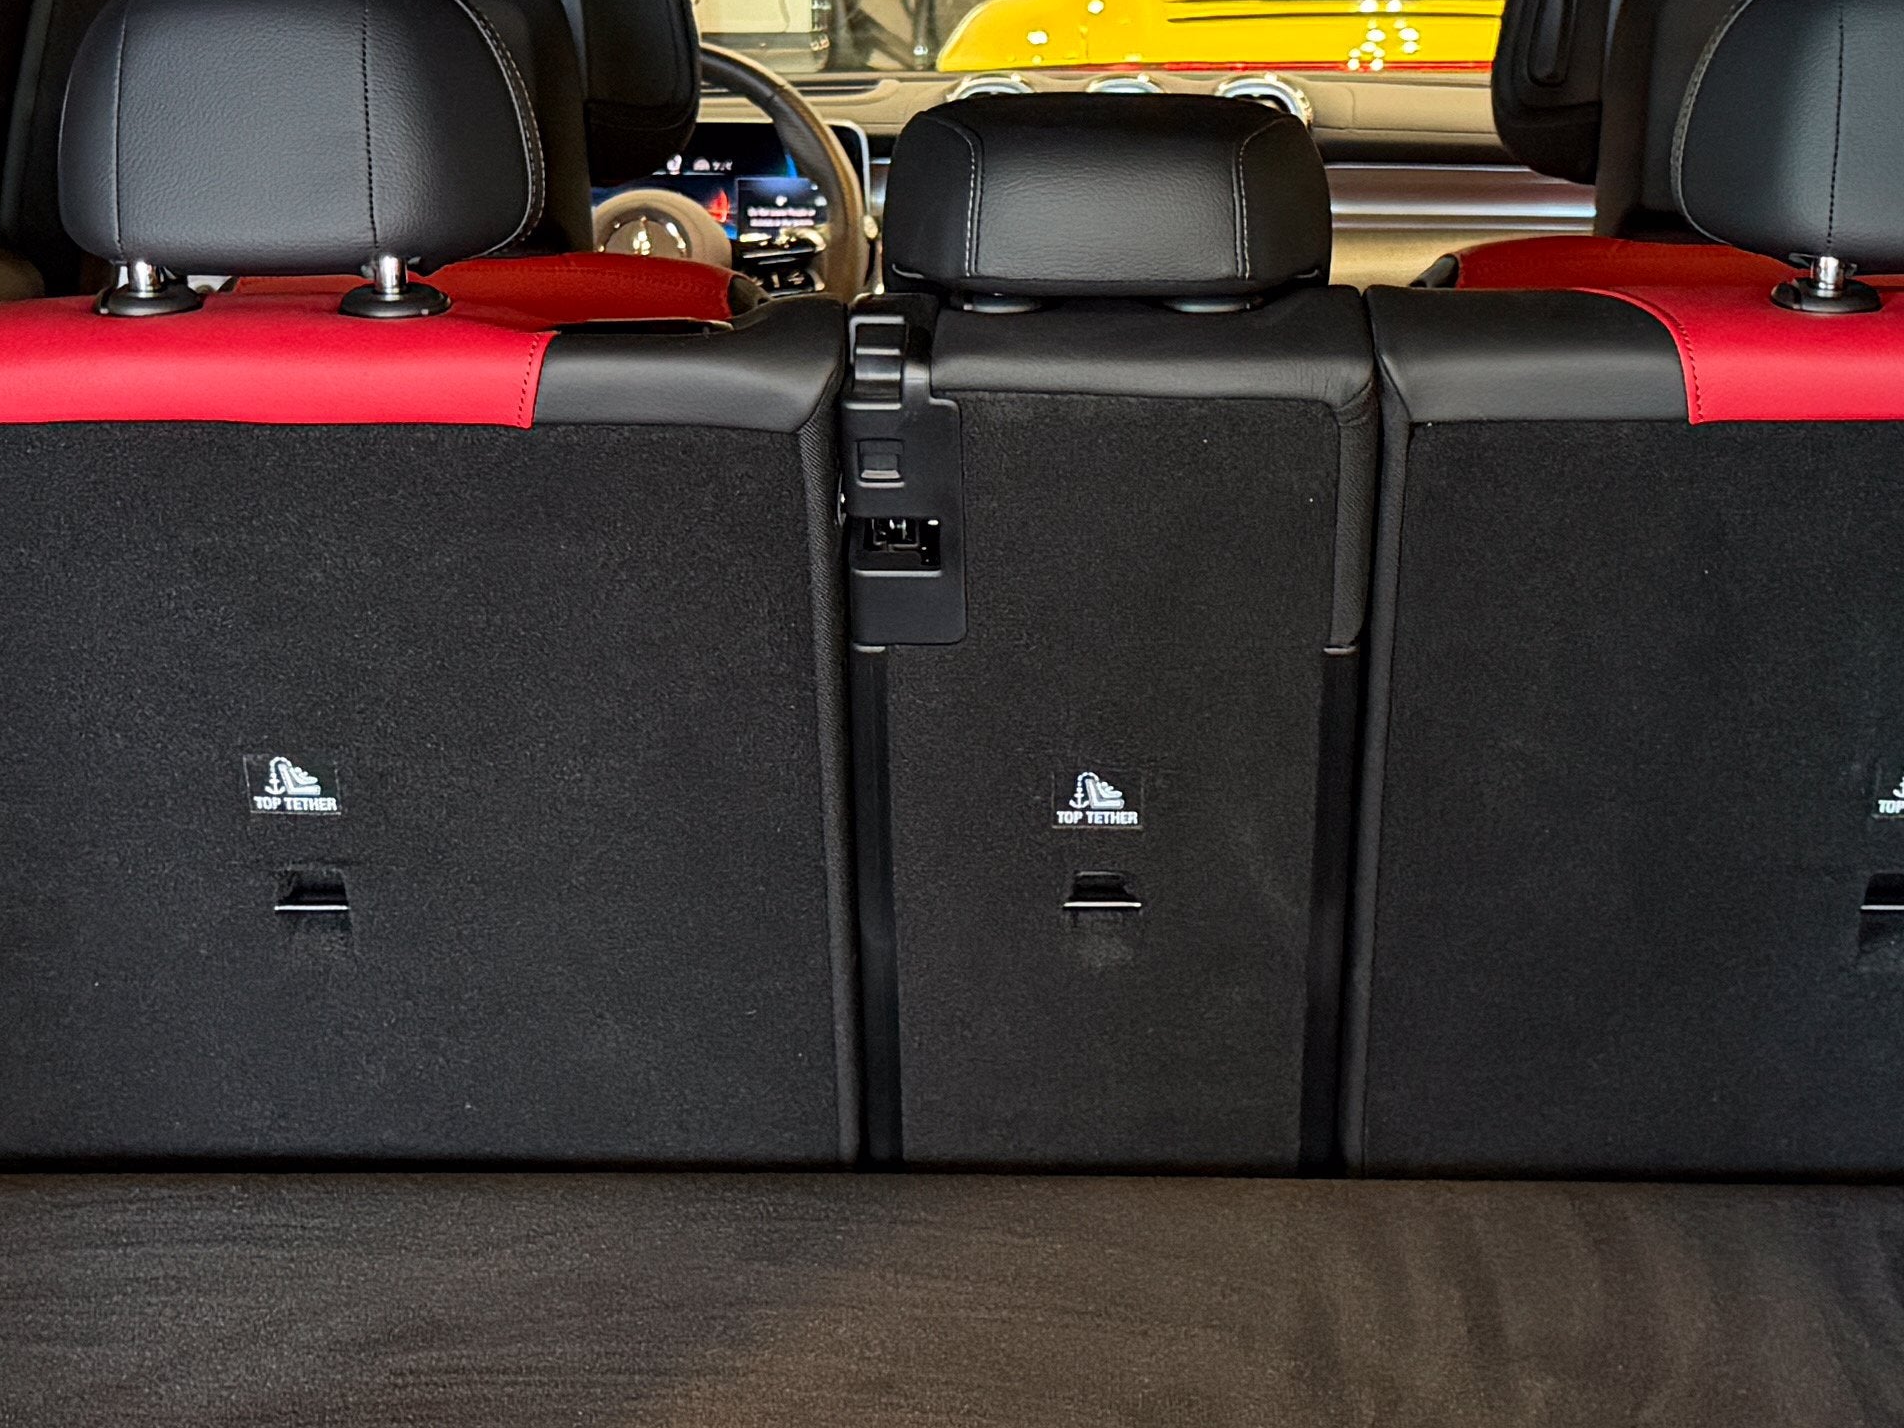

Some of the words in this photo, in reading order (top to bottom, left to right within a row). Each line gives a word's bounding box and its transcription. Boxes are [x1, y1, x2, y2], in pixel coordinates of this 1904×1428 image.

[253, 796, 282, 810] TOP
[284, 797, 338, 811] TETHER
[1056, 811, 1083, 824] TOP
[1086, 811, 1138, 824] TETHER
